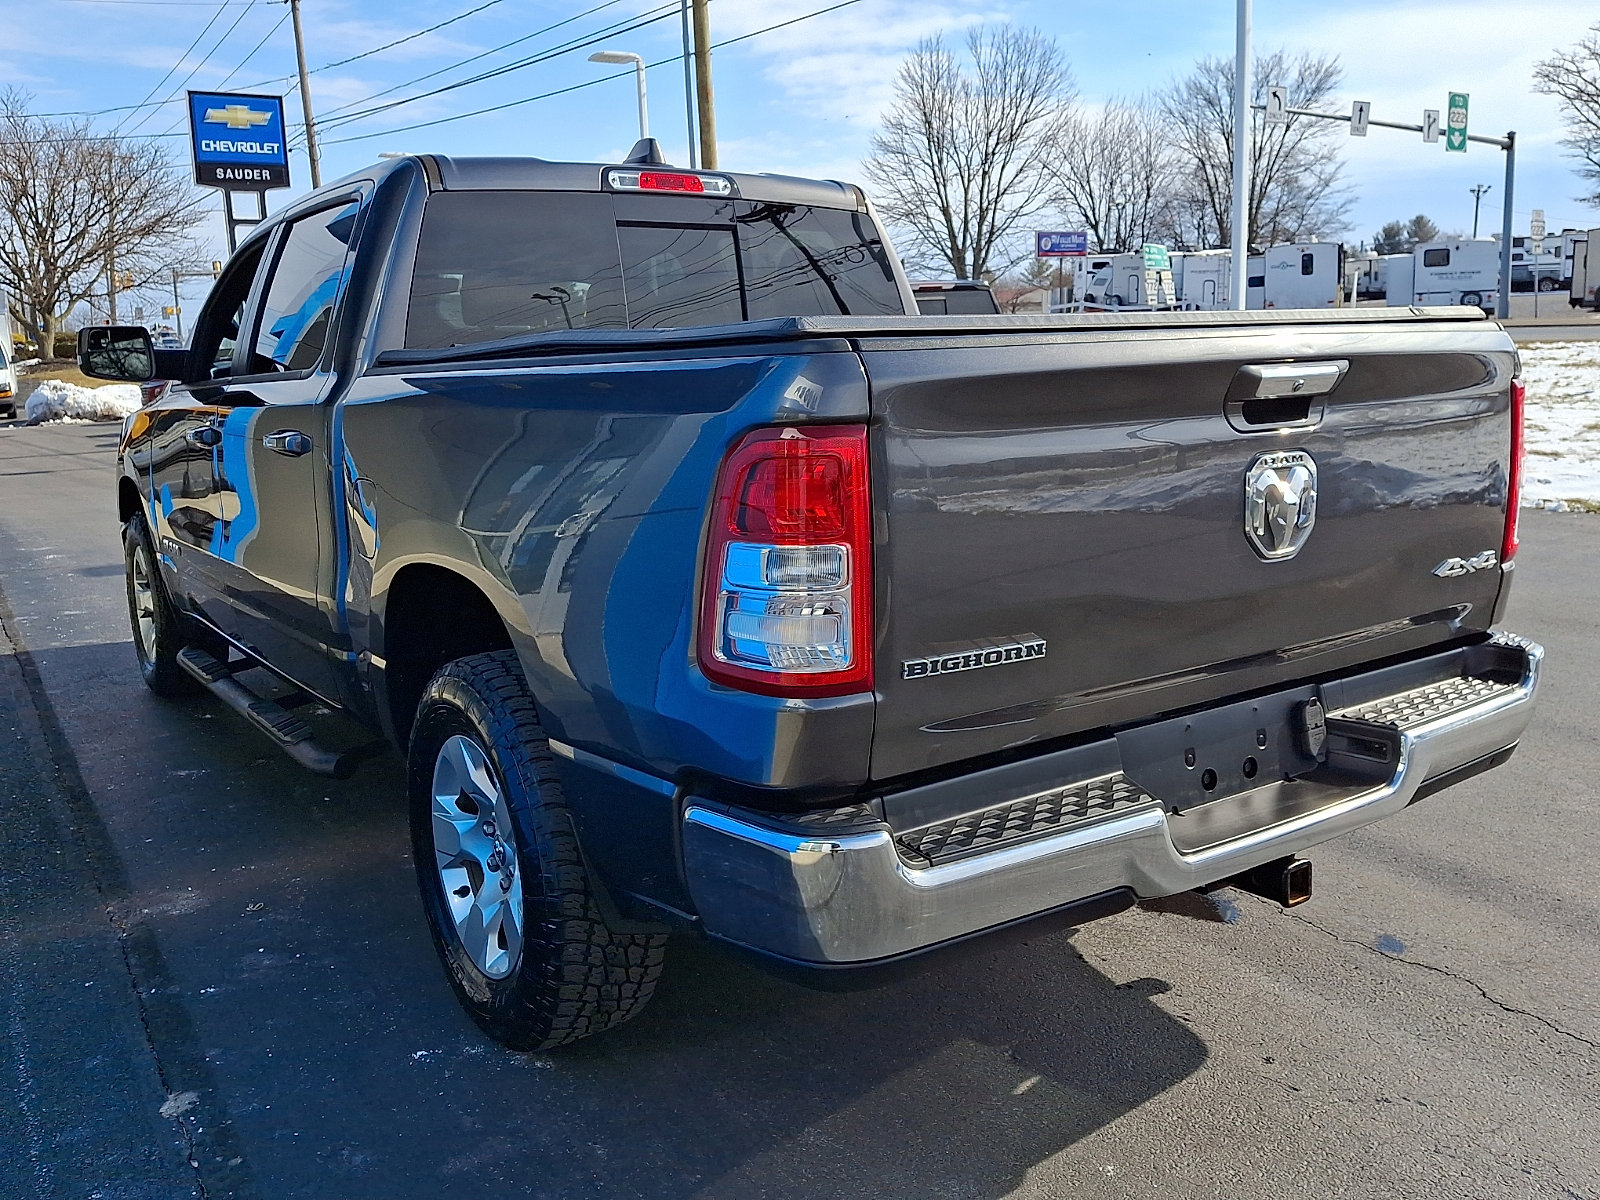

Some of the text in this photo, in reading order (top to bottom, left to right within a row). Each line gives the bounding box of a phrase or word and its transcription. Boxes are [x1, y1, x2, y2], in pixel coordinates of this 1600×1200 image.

[1450, 111, 1466, 124] 222
[201, 140, 280, 154] CHEVROLET
[216, 167, 271, 180] SAUDER
[1261, 454, 1304, 465] RAM
[901, 640, 1047, 680] BIGHORN
